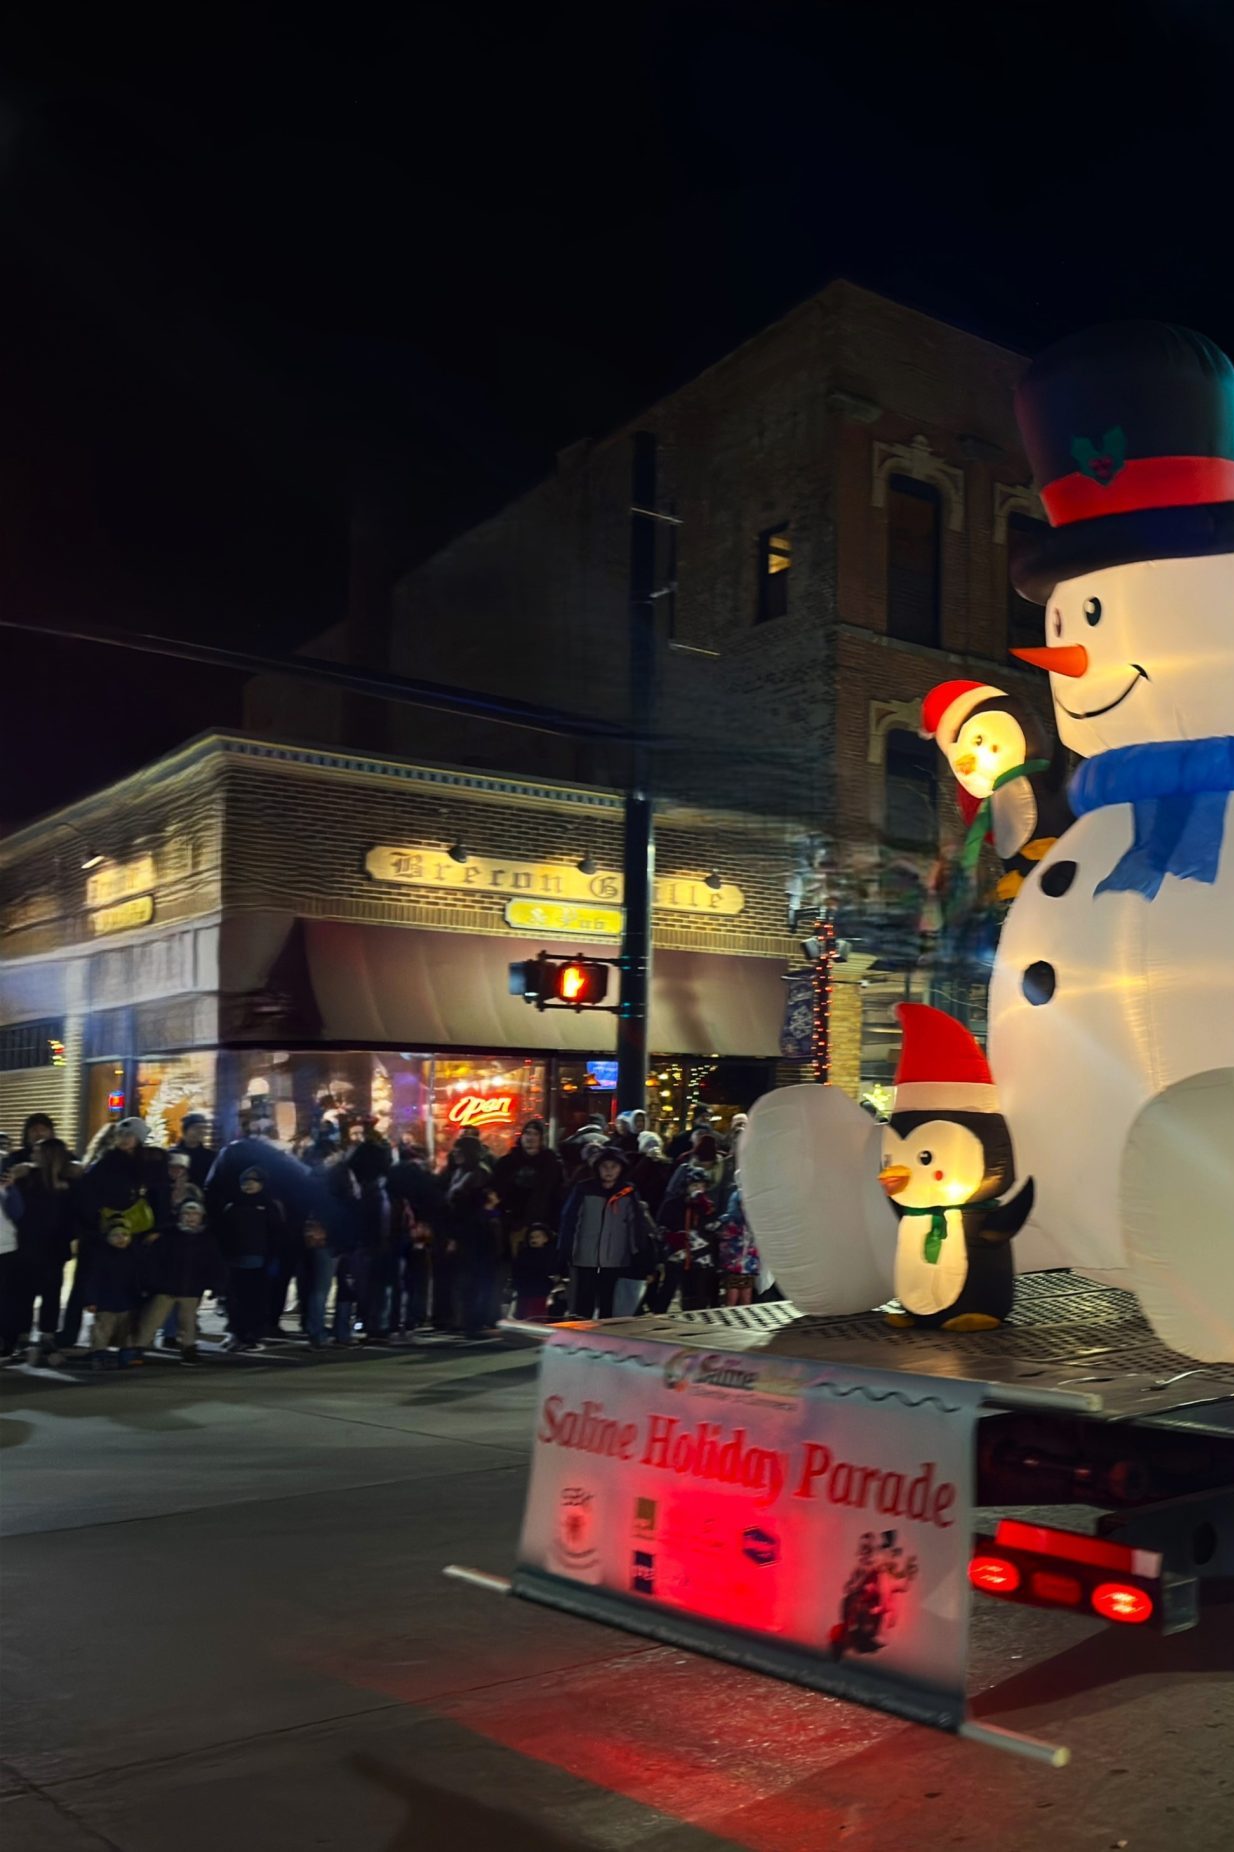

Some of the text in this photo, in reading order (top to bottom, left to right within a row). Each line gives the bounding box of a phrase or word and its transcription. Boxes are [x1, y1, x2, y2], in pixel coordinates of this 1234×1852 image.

[391, 852, 724, 909] Brecon Gille
[448, 1095, 513, 1127] Open
[538, 1395, 957, 1529] Saline Holiday Parade
